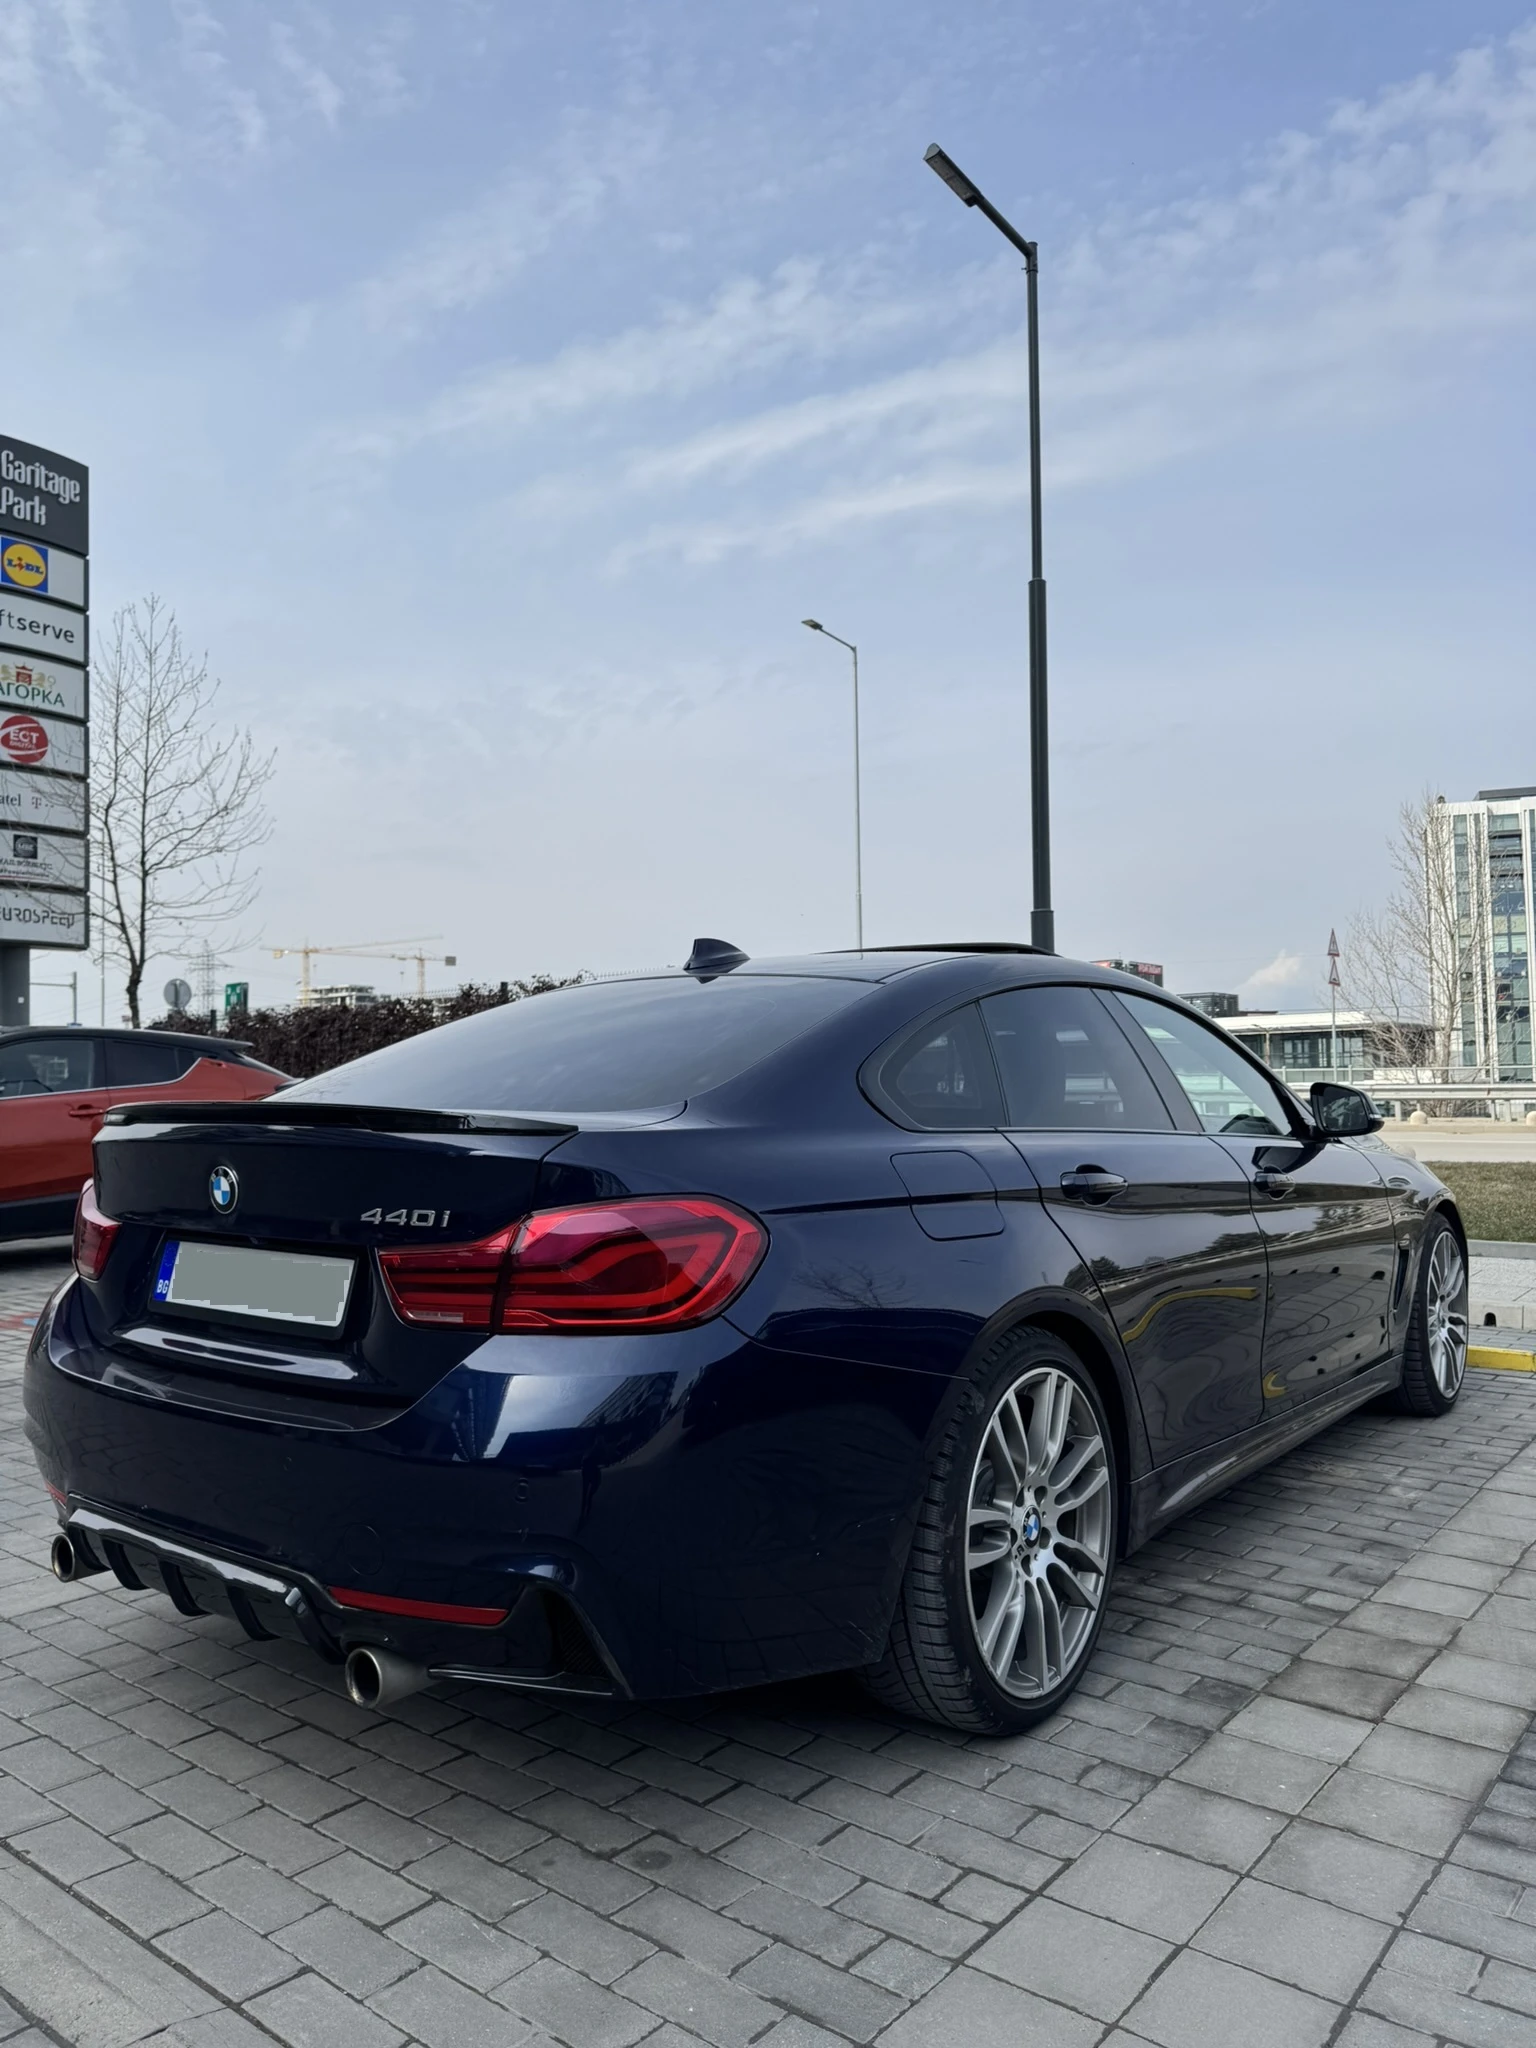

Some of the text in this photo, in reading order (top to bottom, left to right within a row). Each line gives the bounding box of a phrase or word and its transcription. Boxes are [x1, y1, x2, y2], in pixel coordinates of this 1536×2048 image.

[1, 449, 81, 504] Garitage
[0, 486, 46, 526] Park
[156, 1279, 170, 1294] BG
